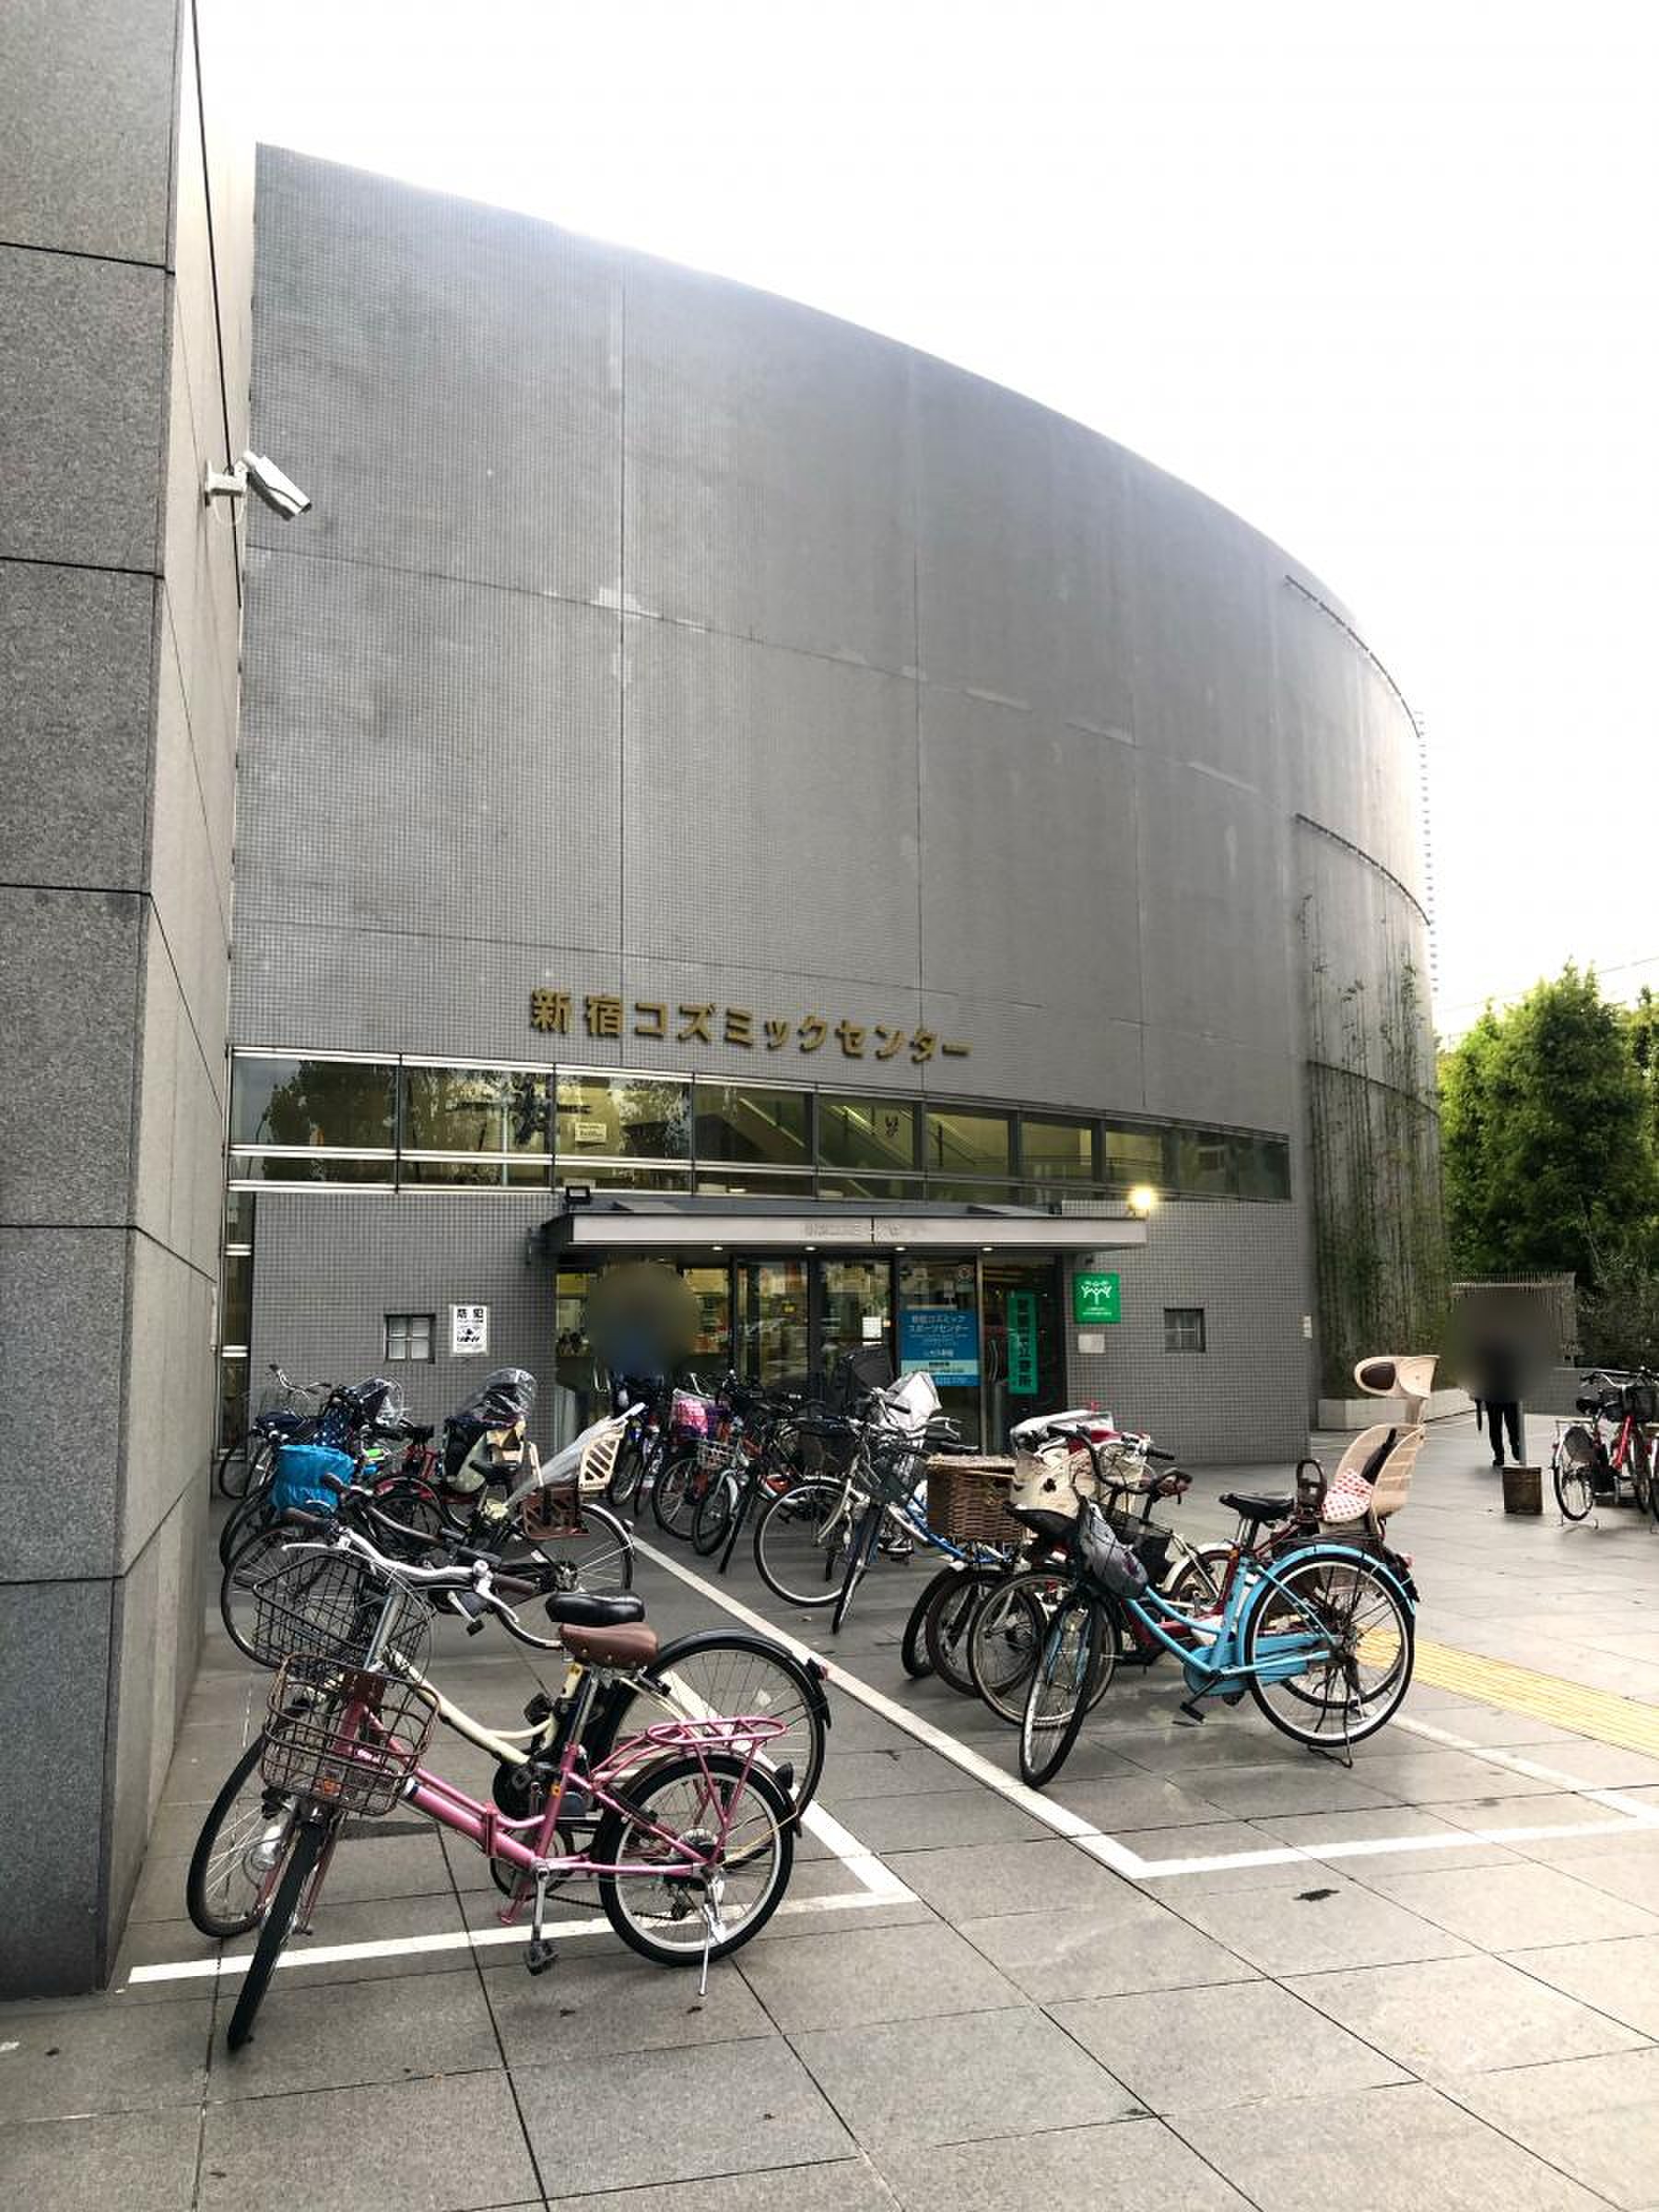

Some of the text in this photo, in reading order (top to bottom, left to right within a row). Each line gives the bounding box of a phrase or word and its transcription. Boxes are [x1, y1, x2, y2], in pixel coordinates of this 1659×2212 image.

[530, 988, 972, 1062] 新宿コズミックセンター
